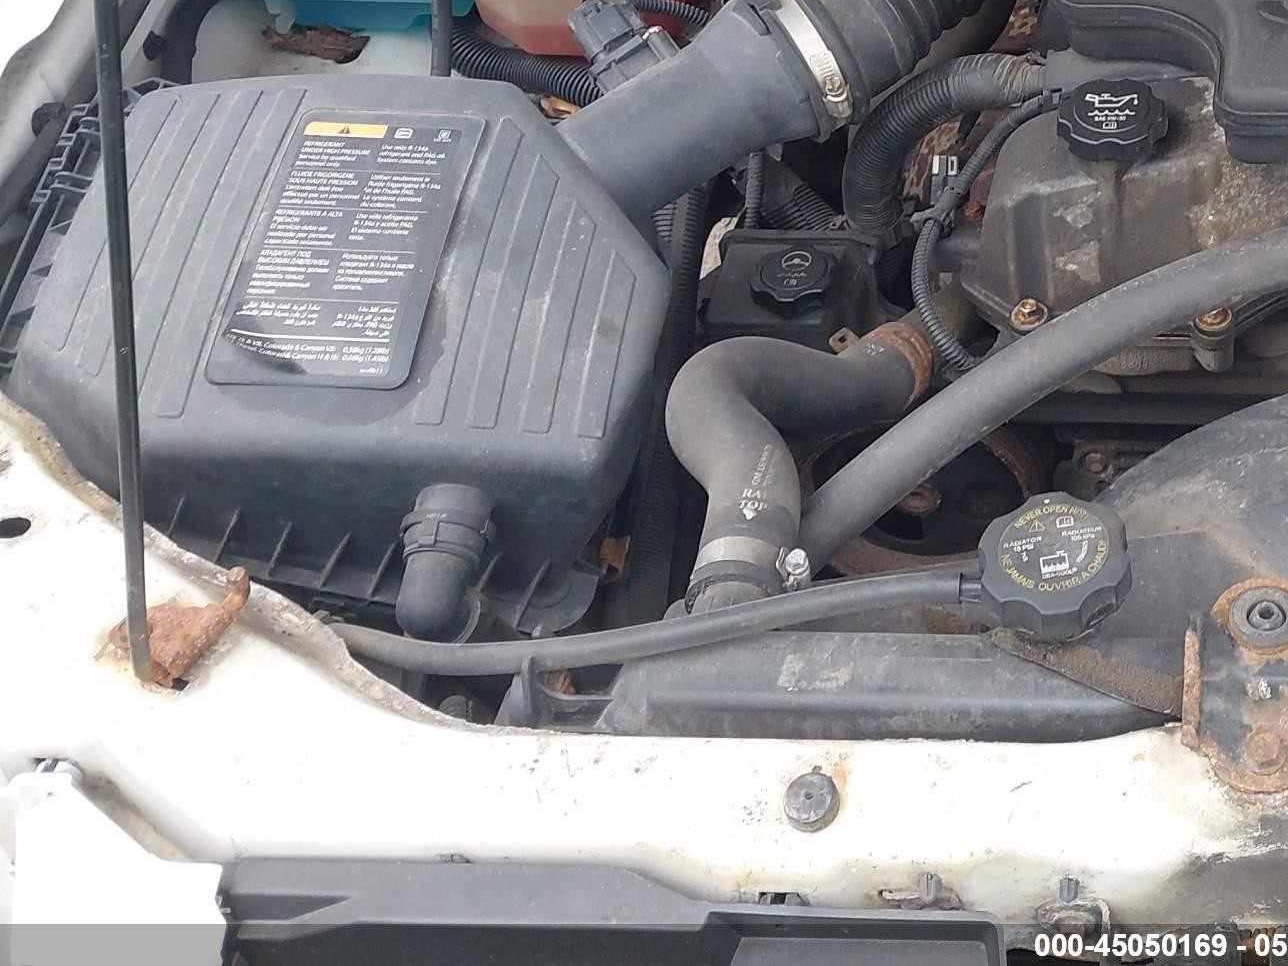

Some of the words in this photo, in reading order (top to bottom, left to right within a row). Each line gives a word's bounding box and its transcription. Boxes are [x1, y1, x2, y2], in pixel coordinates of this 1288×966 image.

[739, 499, 768, 511] TOP
[1014, 507, 1042, 529] NEVER
[1042, 505, 1069, 515] OPEN
[1006, 566, 1036, 589] JAMAIS
